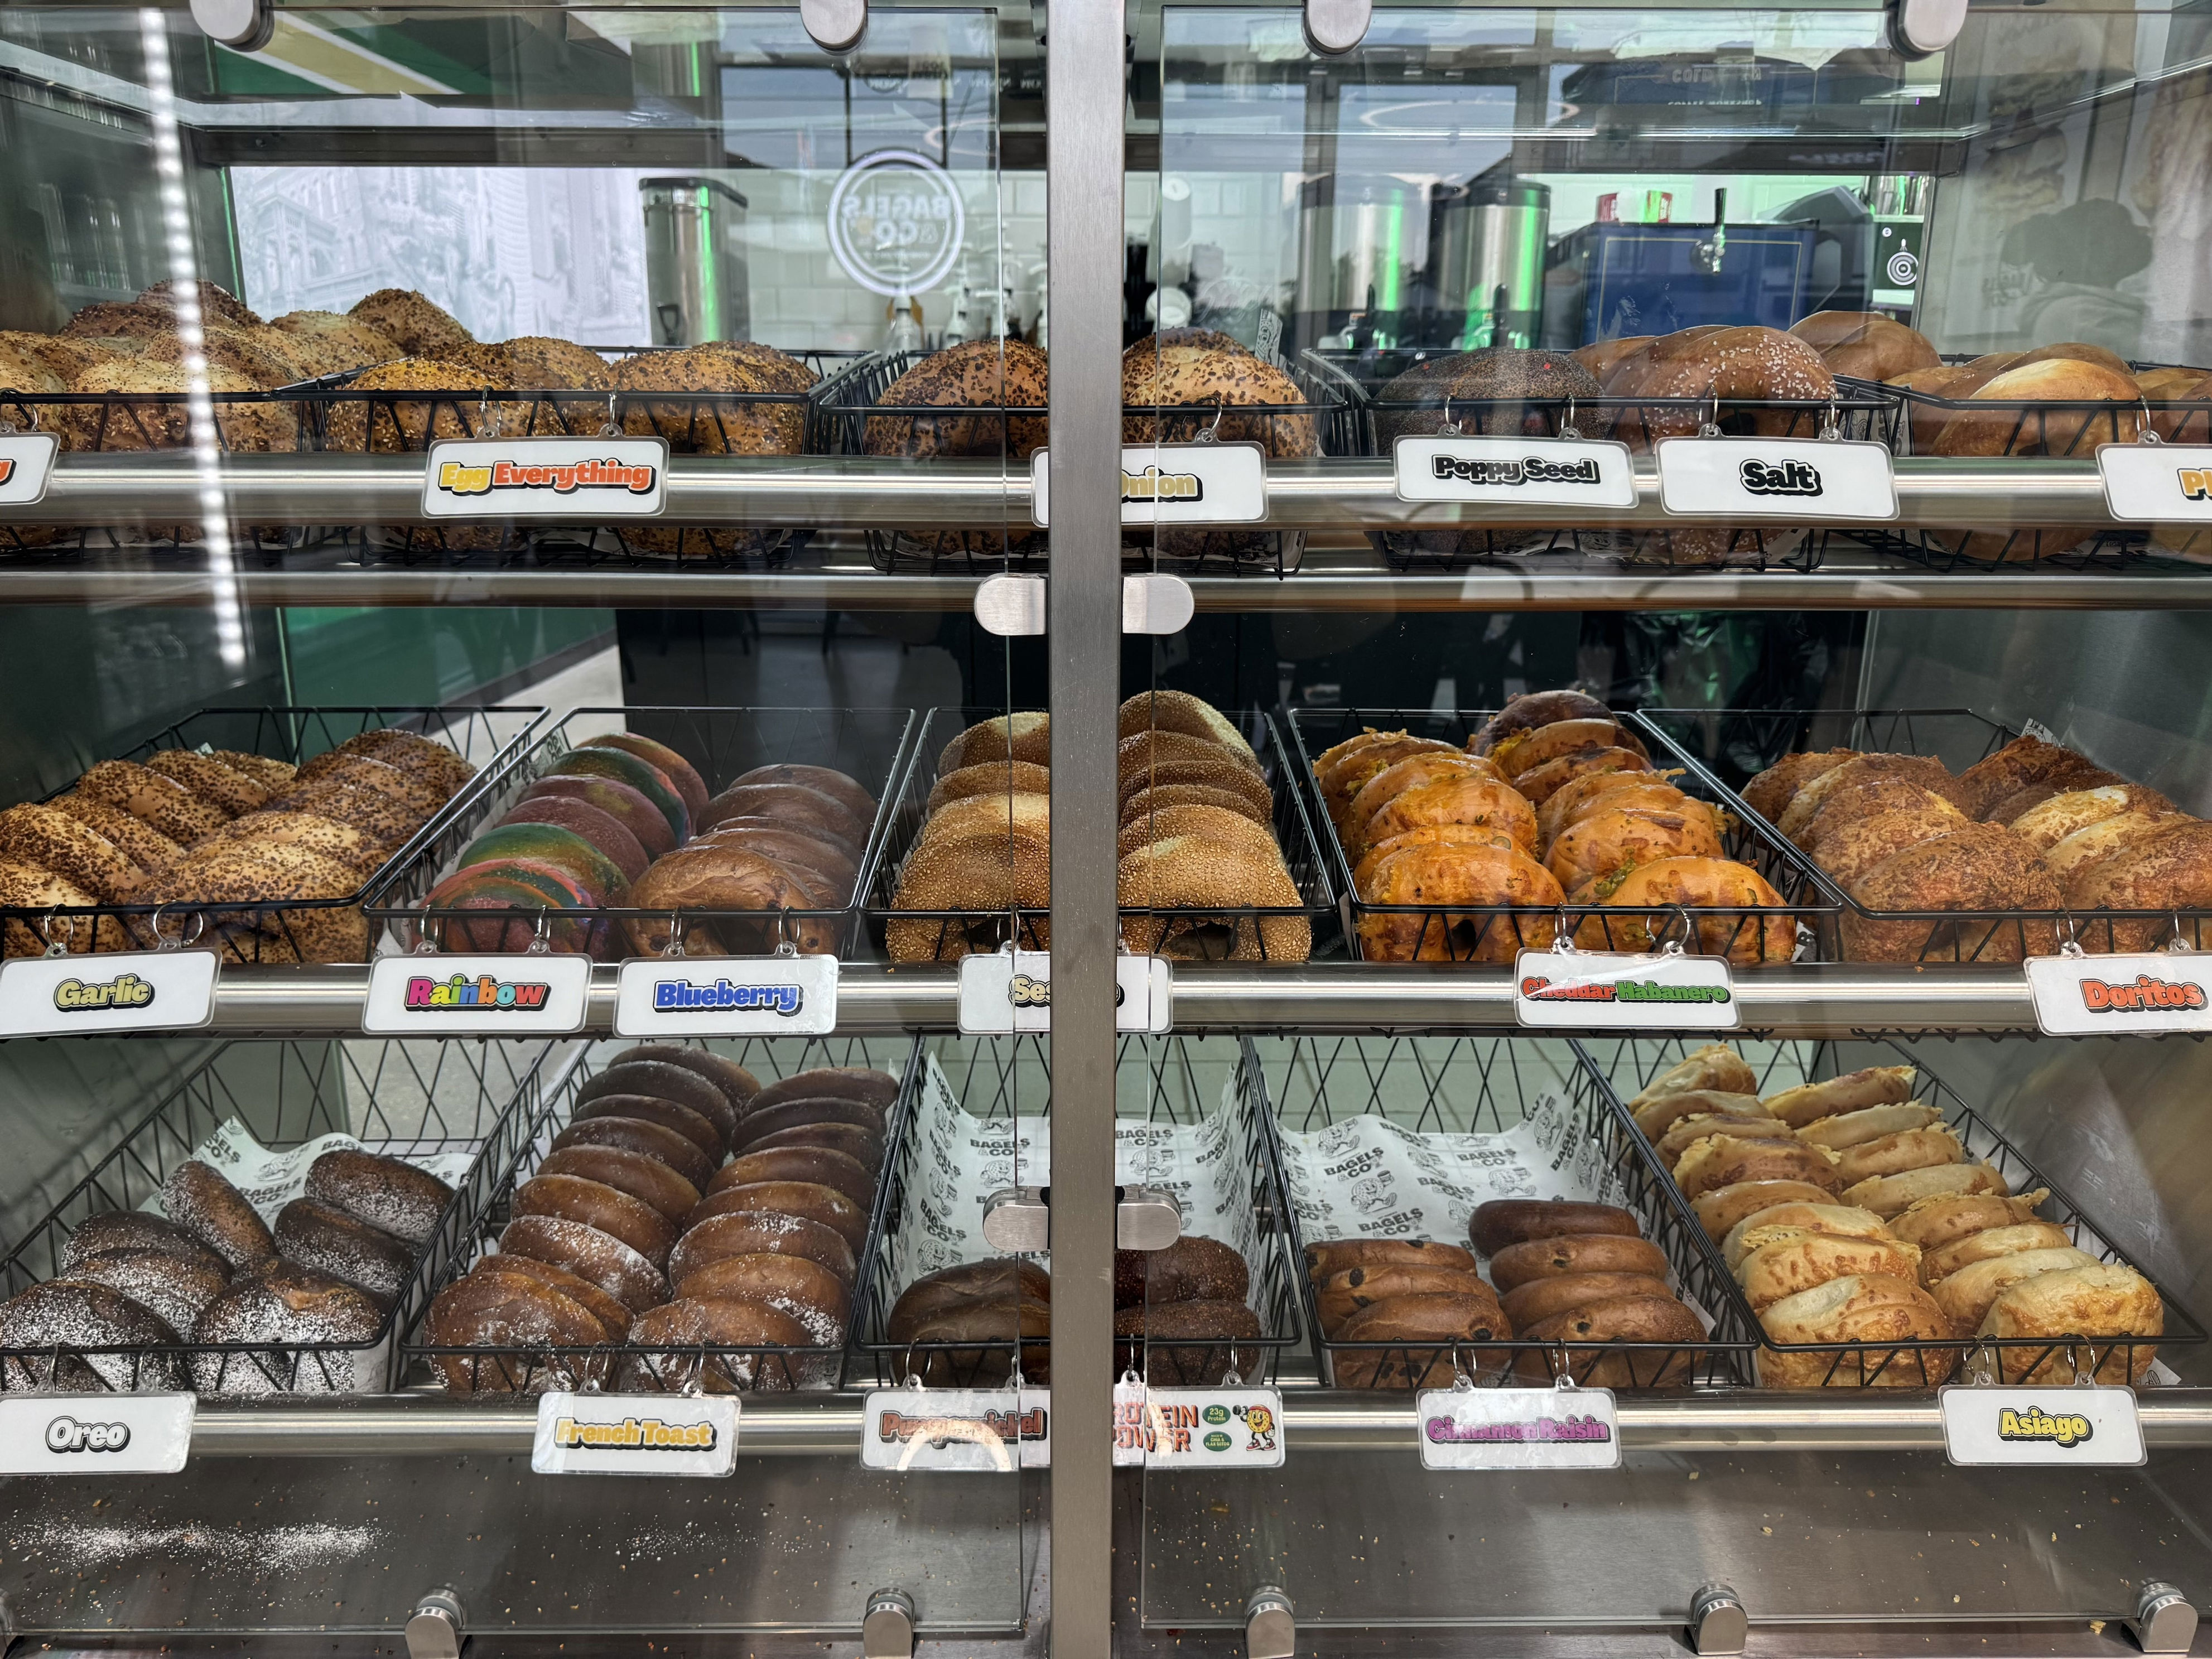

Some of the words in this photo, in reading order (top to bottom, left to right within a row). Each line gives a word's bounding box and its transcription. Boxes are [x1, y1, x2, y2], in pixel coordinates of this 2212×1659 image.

[438, 461, 491, 496] Egg
[492, 458, 656, 495] Everything
[1432, 455, 1524, 485] Poppy
[1523, 456, 1600, 484] Seed
[1739, 459, 1823, 496] Salt
[54, 973, 155, 1012] Garlic
[404, 973, 551, 1011] Rainbow
[653, 978, 803, 1017] Blueberry
[1615, 980, 1731, 1003] Habanero
[2079, 974, 2209, 1013] Doritos
[1457, 1148, 1517, 1161] BAGELS
[1550, 1112, 1579, 1171] BAGELS
[1324, 1146, 1385, 1176] BAGELS
[921, 1198, 967, 1239] BAGELS
[1357, 1207, 1424, 1232] BAGELS
[1209, 1407, 1224, 1417] 23g
[1425, 1414, 1538, 1444] Cinnamon
[1536, 1414, 1611, 1443] Raisin
[1998, 1405, 2093, 1448] Asiago
[45, 1415, 131, 1453] Oreo
[553, 1416, 644, 1450] French
[640, 1418, 717, 1451] Toast
